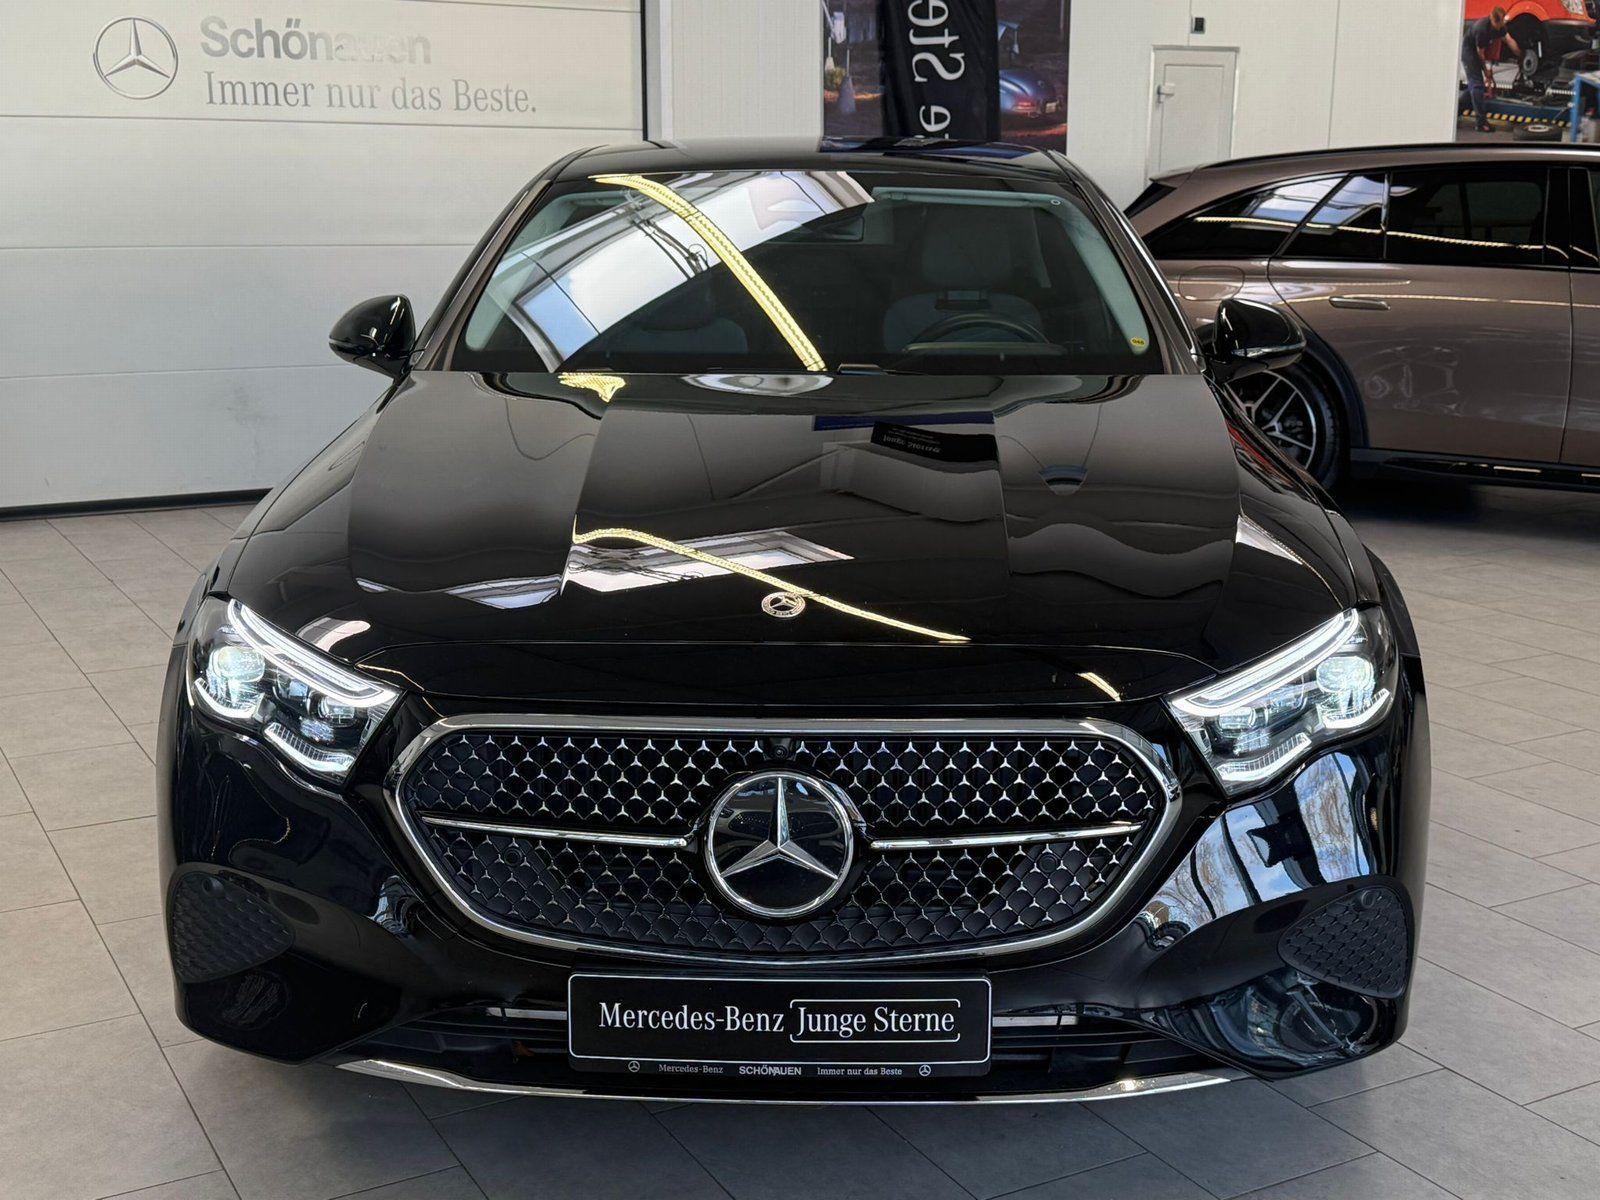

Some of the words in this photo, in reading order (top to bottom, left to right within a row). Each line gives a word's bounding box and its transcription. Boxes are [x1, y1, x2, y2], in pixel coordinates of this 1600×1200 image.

[204, 71, 315, 107] Immer
[326, 83, 381, 109] nur
[392, 77, 442, 111] das
[452, 79, 537, 113] Beste.
[598, 1002, 785, 1032] Mercedes-Benz
[797, 1006, 867, 1038] Junge
[874, 1006, 955, 1032] Sterne
[658, 1063, 724, 1074] Mercedes-Benz
[738, 1065, 802, 1077] SCHÖNAUEN
[817, 1067, 845, 1076] Immer
[847, 1068, 862, 1076] nur
[864, 1067, 878, 1076] das
[880, 1067, 903, 1076] Beste
